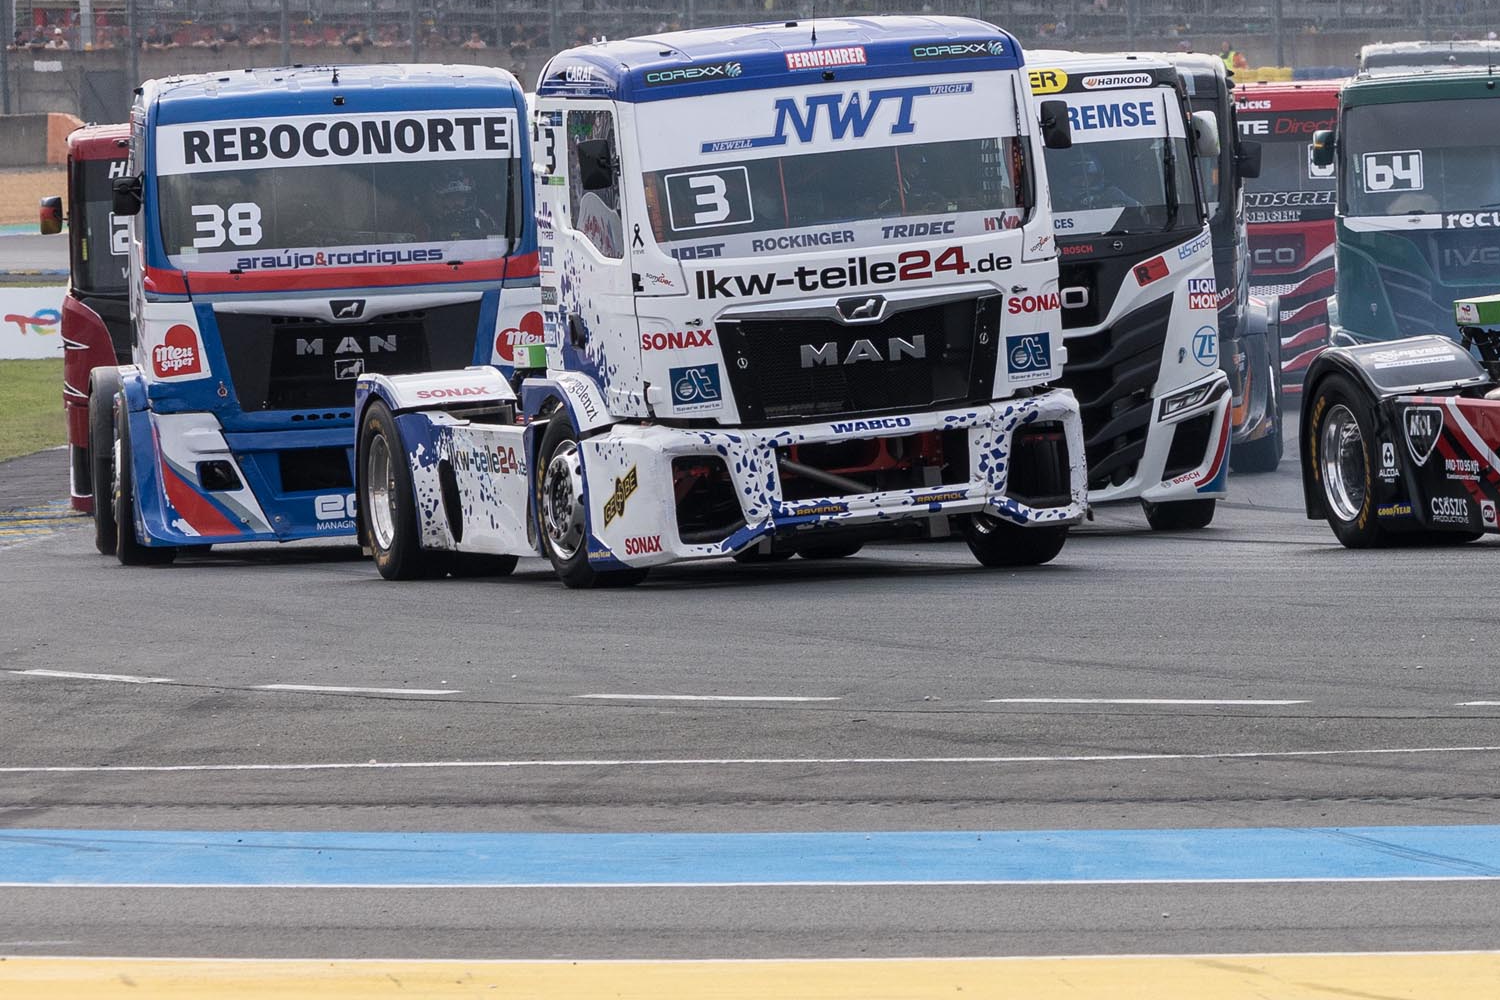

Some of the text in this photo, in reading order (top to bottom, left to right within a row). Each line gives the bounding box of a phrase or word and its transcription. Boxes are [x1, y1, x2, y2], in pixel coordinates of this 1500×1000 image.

[786, 47, 866, 69] FERNFAHRER
[914, 43, 987, 57] COREXX
[565, 66, 594, 82] CARAT
[647, 65, 724, 84] COREXX
[711, 139, 753, 151] NEWELL
[928, 83, 970, 95] WRIGHT
[183, 116, 509, 166] REBOCONORTE
[1366, 155, 1422, 191] 64
[689, 174, 731, 225] 3
[191, 202, 263, 249] 38
[881, 220, 956, 240] TRIDEC
[752, 230, 855, 252] ROCKINGER
[1062, 244, 1093, 255] BOSCH
[236, 248, 443, 270] araújo&rodrigues
[695, 245, 1012, 300] lkw-teile24.de
[296, 334, 397, 356] MAN
[642, 329, 714, 351] SONAX
[1197, 334, 1217, 358] ZF
[155, 344, 194, 363] Meu
[800, 334, 927, 369] MAN
[161, 355, 195, 372] super
[416, 386, 490, 400] SONAX
[831, 416, 912, 433] WABCO
[1173, 471, 1201, 485] BOSCH
[1378, 468, 1400, 478] ALCOA
[917, 492, 965, 504] RAVENOL
[796, 503, 845, 517] RAVENOL
[1378, 504, 1412, 517] GOODYEAR
[625, 535, 663, 556] SONAX
